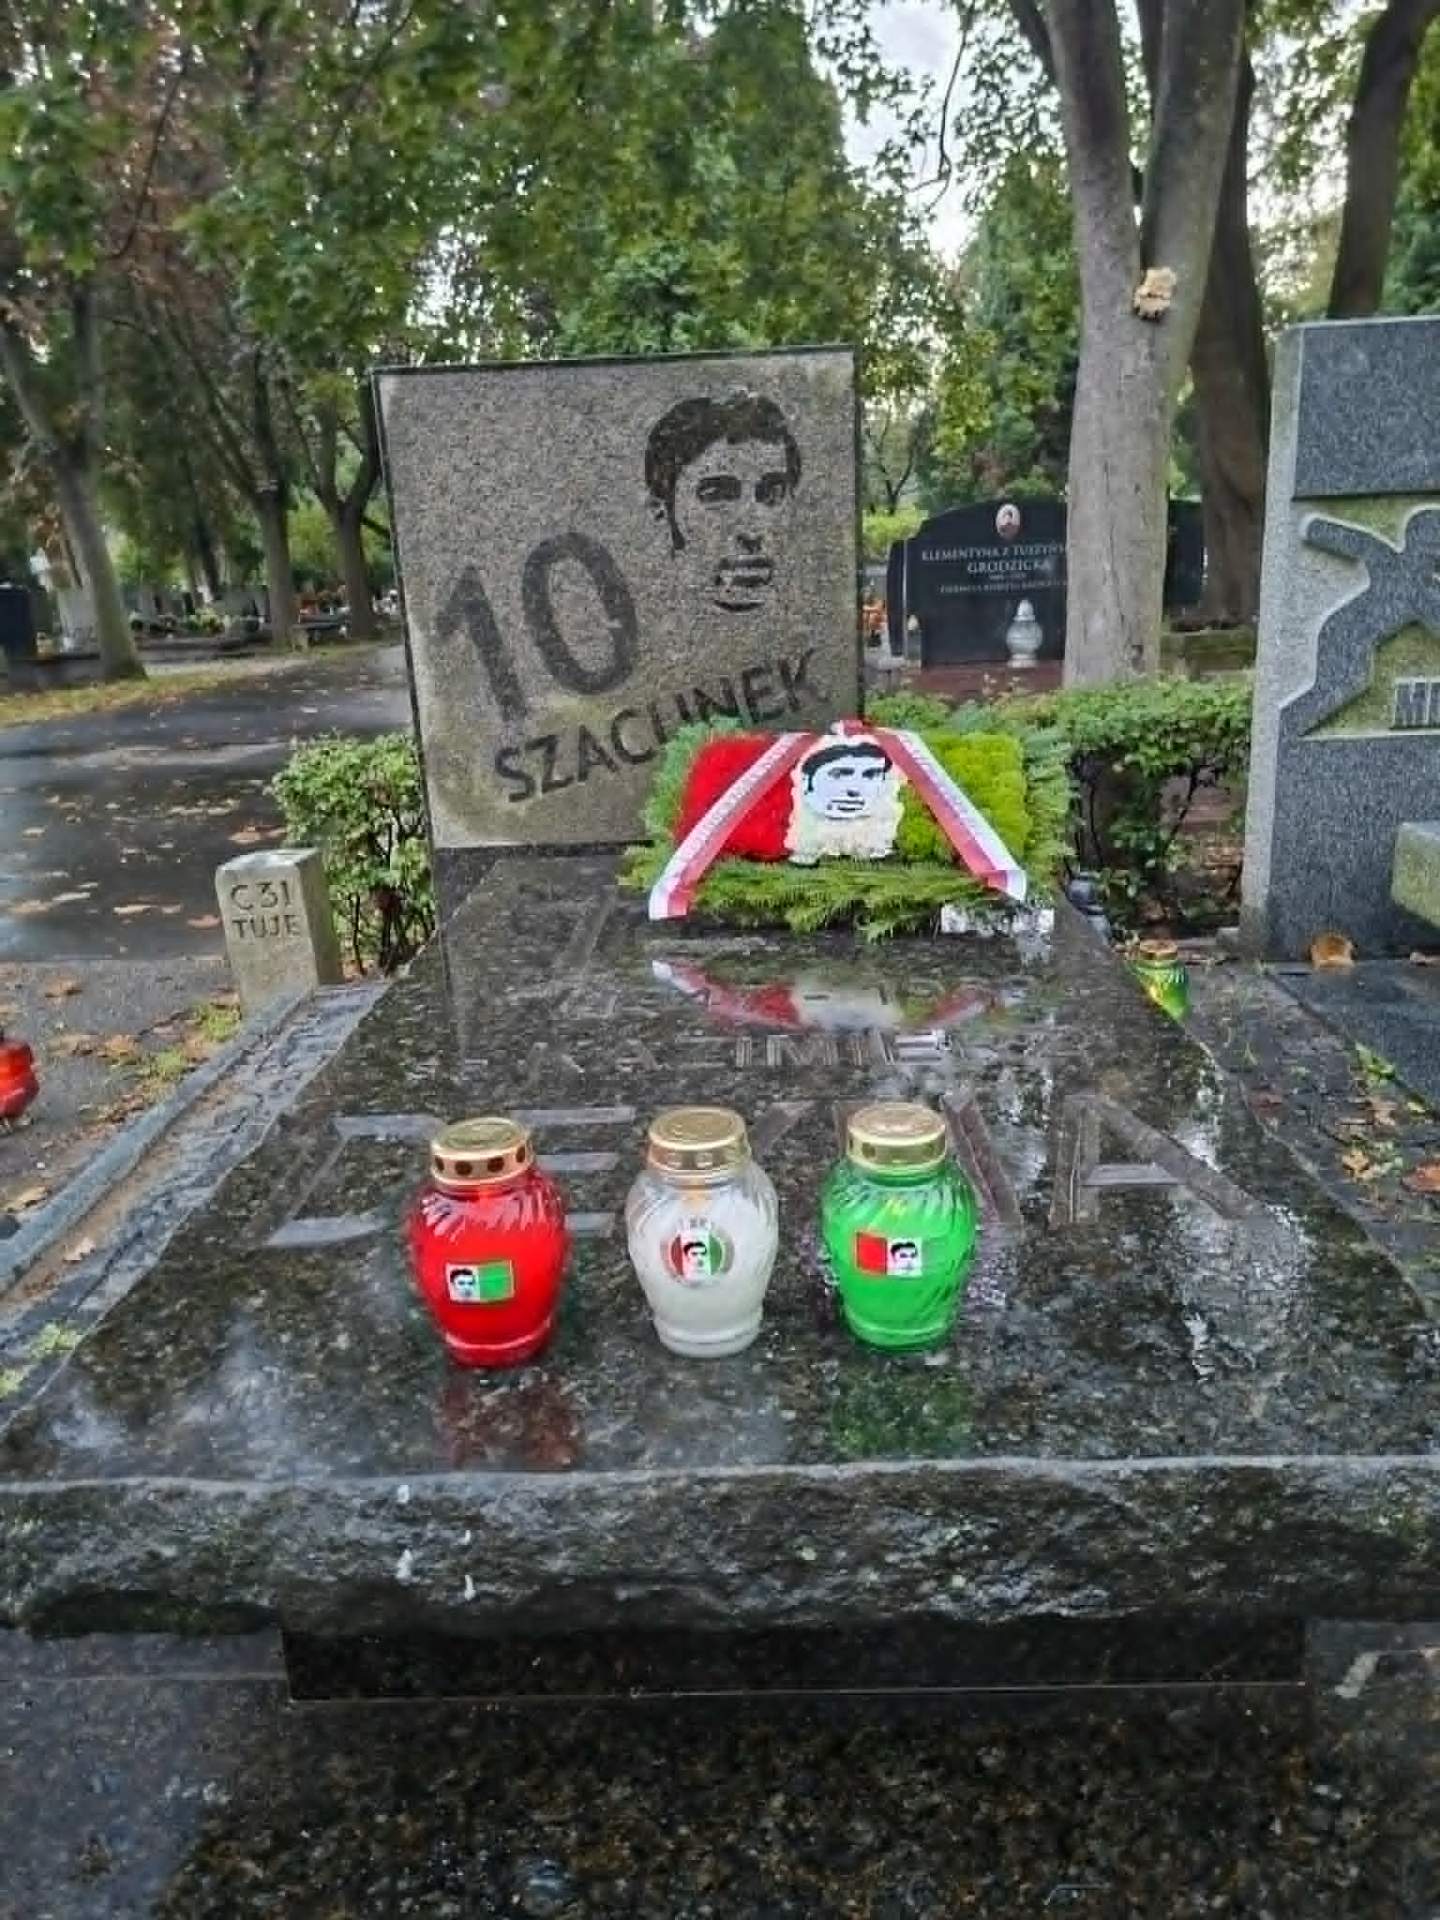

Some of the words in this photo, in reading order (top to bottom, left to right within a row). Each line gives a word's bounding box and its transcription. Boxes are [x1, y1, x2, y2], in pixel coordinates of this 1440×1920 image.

[436, 532, 638, 727] 10
[231, 885, 253, 910] C
[256, 881, 292, 908] 31
[232, 914, 301, 939] TUJE
